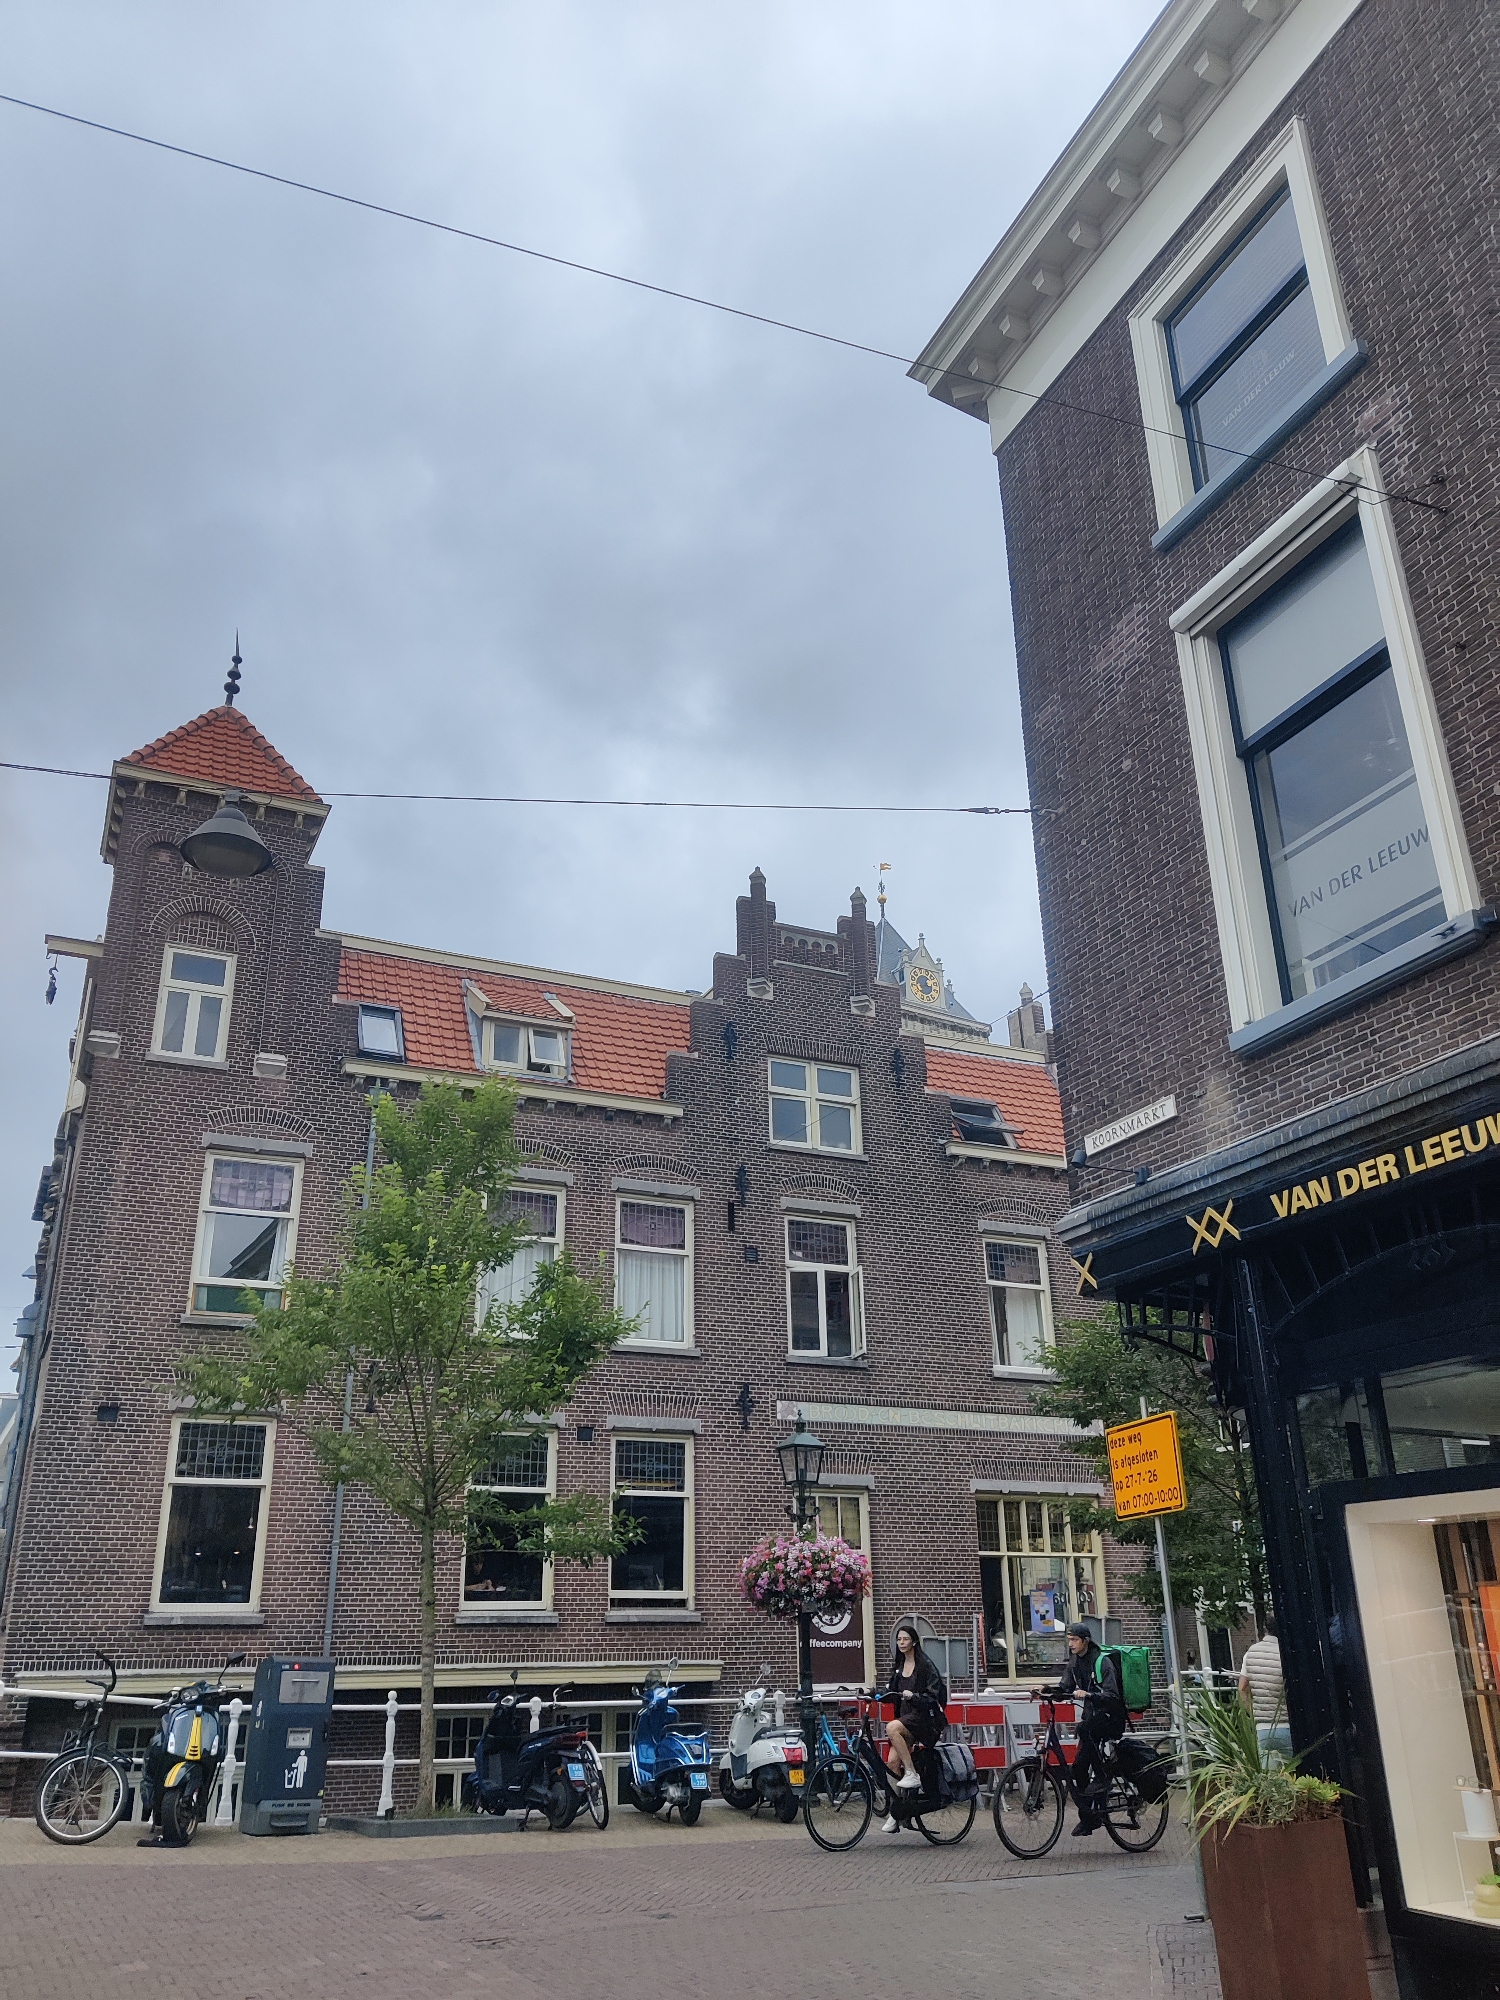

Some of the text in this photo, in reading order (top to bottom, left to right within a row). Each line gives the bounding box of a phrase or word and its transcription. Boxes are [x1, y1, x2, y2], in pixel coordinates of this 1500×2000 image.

[1222, 349, 1296, 427] VAN DER LEEUW
[1288, 825, 1429, 918] VAN DER LEEUW
[1091, 1103, 1167, 1150] KOORNMARKT
[1270, 1175, 1333, 1219] VAN
[1336, 1152, 1401, 1198] DER
[1110, 1432, 1141, 1449] deze weg
[1120, 1449, 1158, 1470] afgesloten
[1116, 1469, 1157, 1492] op 27-7-'26
[1118, 1487, 1178, 1511] van 07:00-10:00
[799, 1638, 862, 1649] ffeecompany
